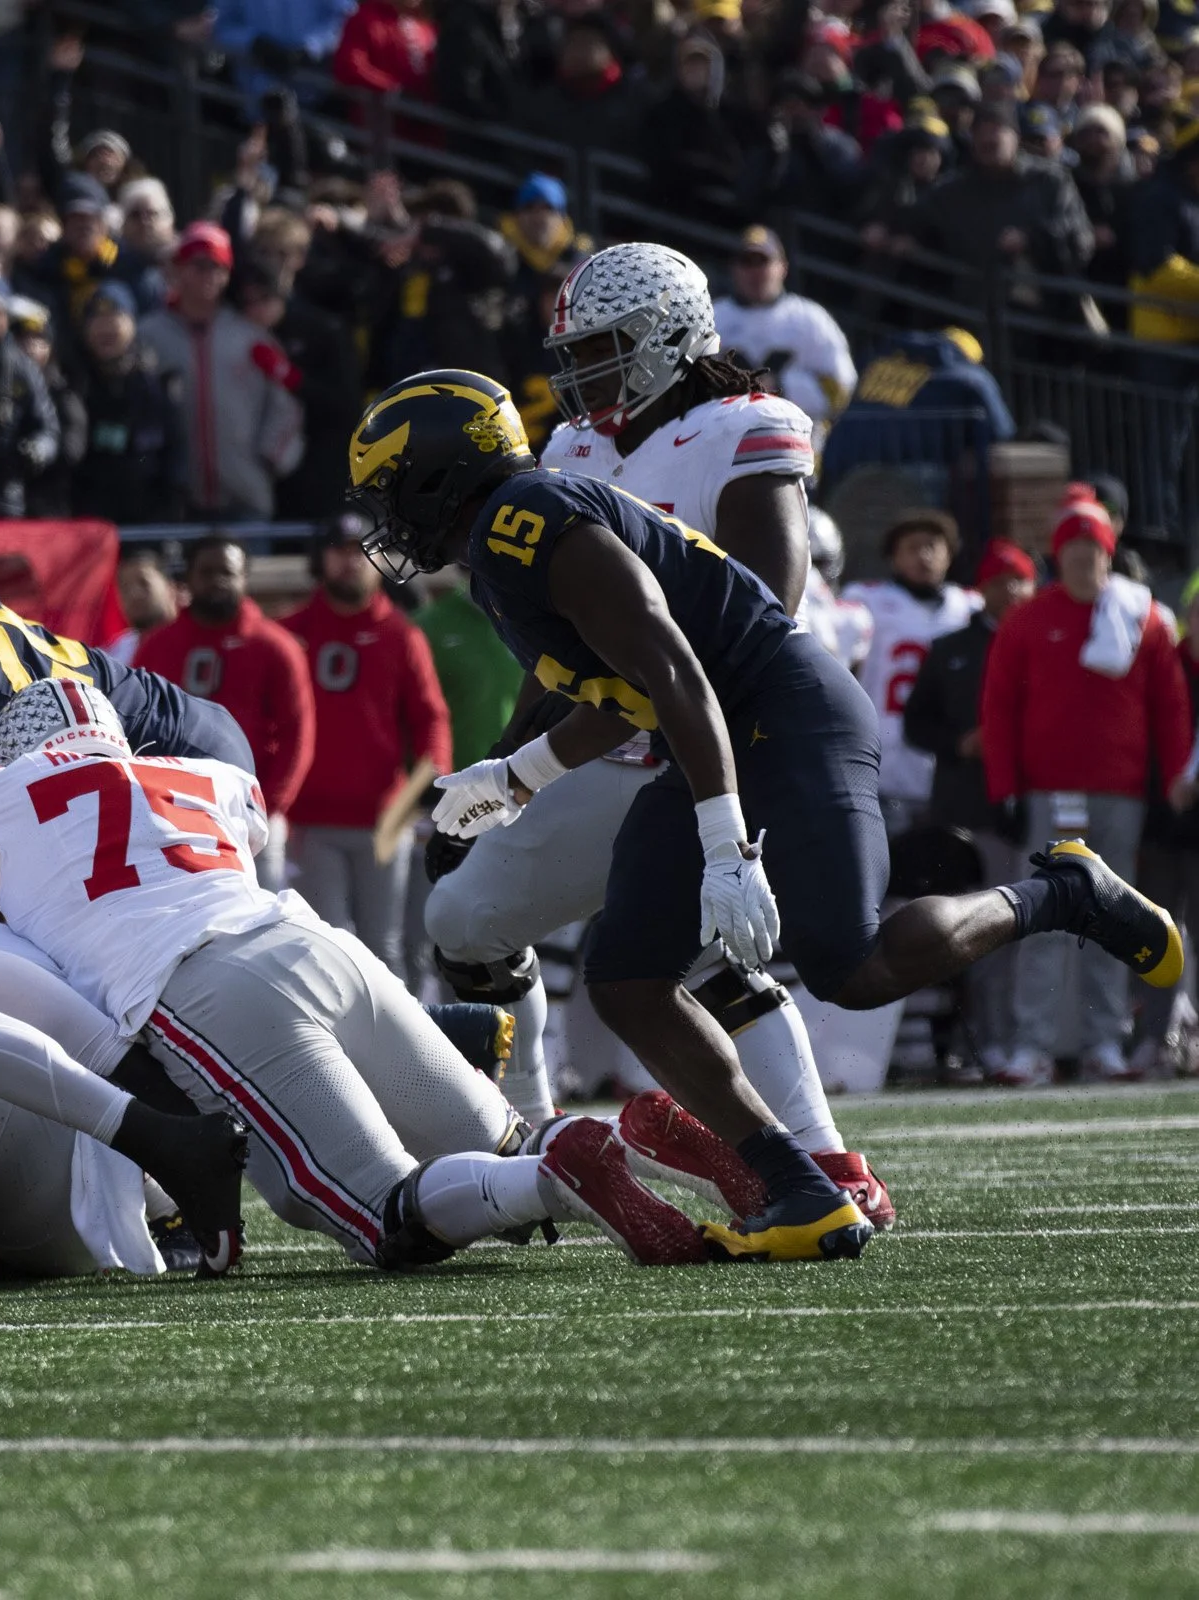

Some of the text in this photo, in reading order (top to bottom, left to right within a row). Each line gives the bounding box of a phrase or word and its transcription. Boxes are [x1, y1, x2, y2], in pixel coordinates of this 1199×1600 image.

[487, 504, 546, 567] 15
[316, 641, 358, 692] O
[27, 761, 245, 902] 75
